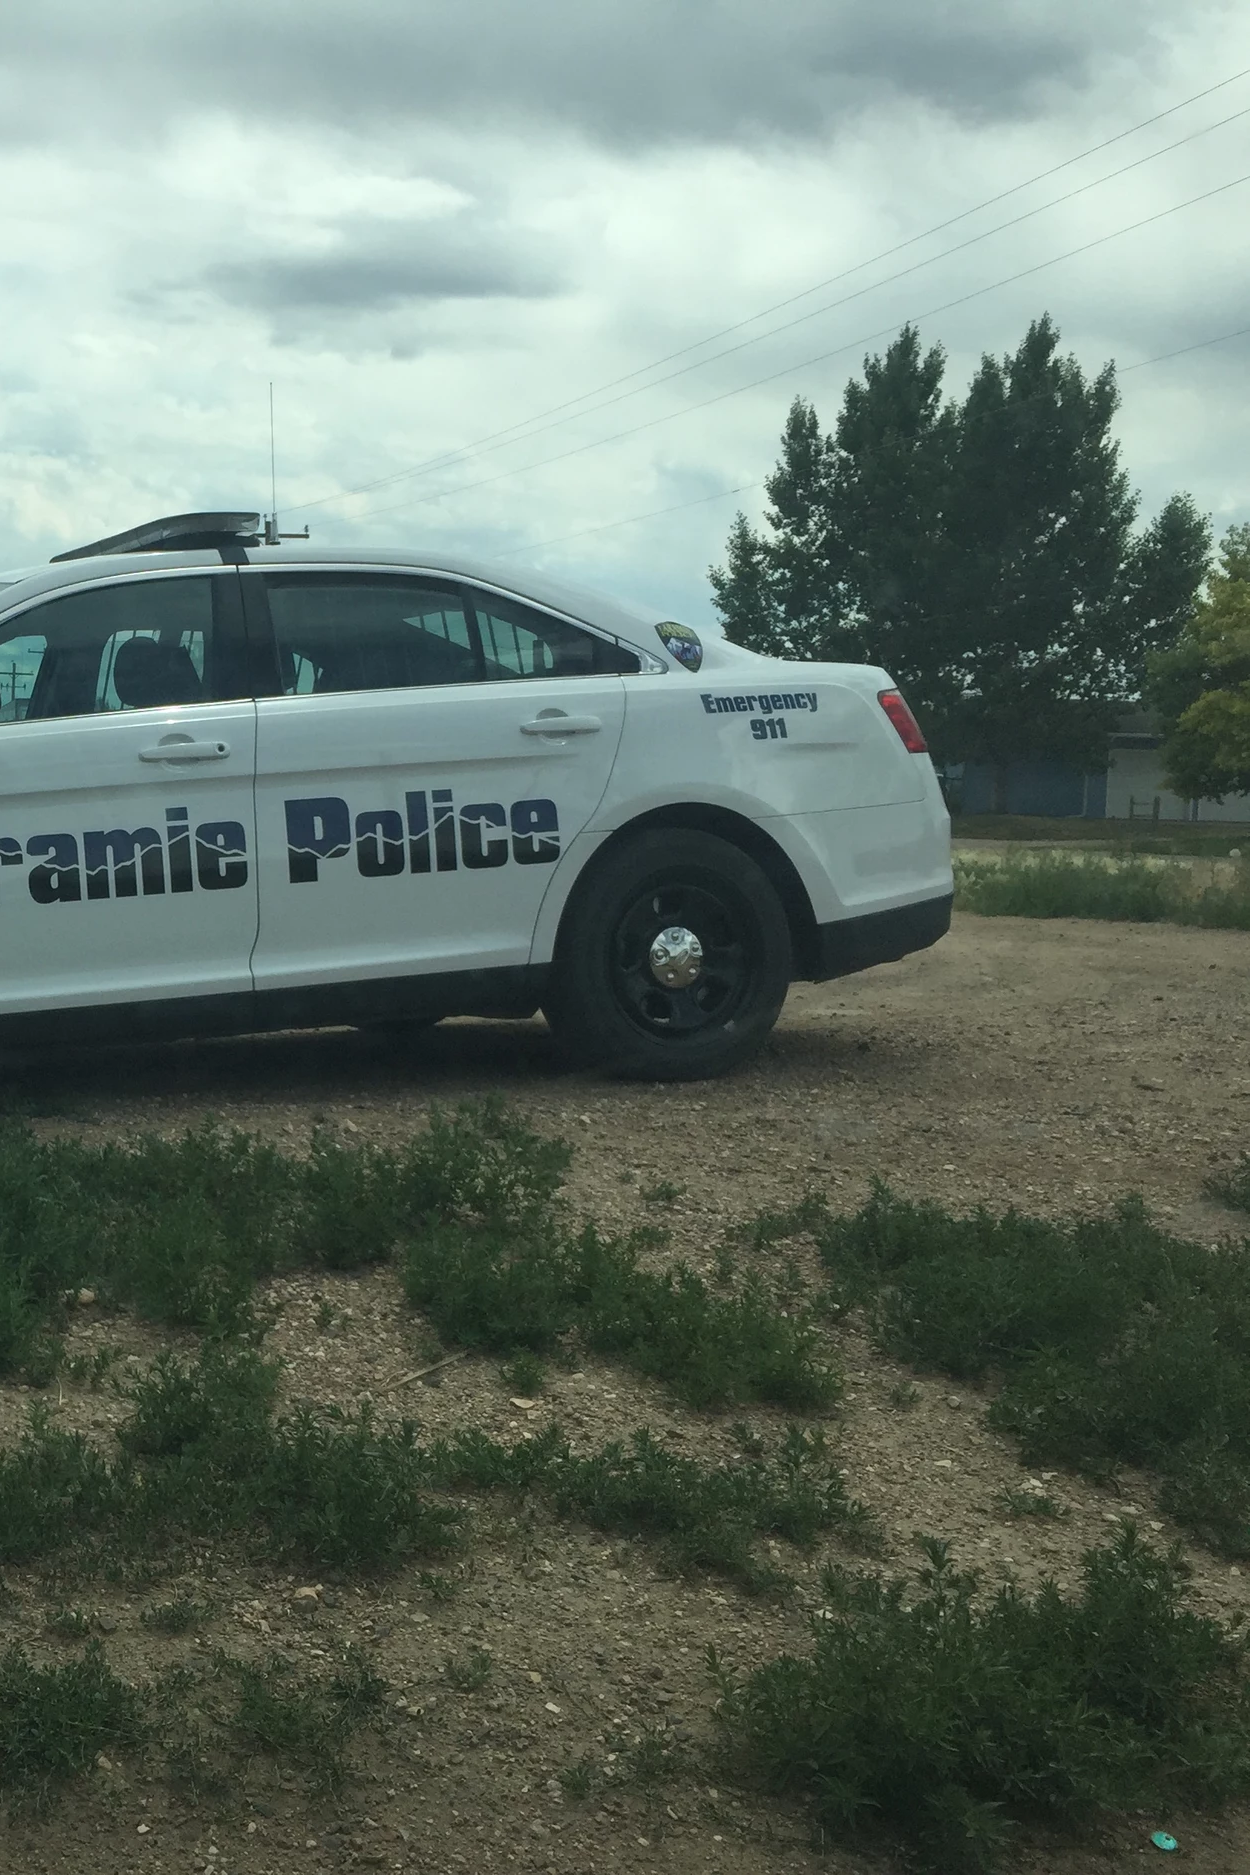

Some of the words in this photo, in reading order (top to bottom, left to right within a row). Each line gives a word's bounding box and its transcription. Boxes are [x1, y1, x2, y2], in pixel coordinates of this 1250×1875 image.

[700, 692, 818, 714] Emergency
[750, 717, 788, 740] 911
[284, 788, 562, 884] Police
